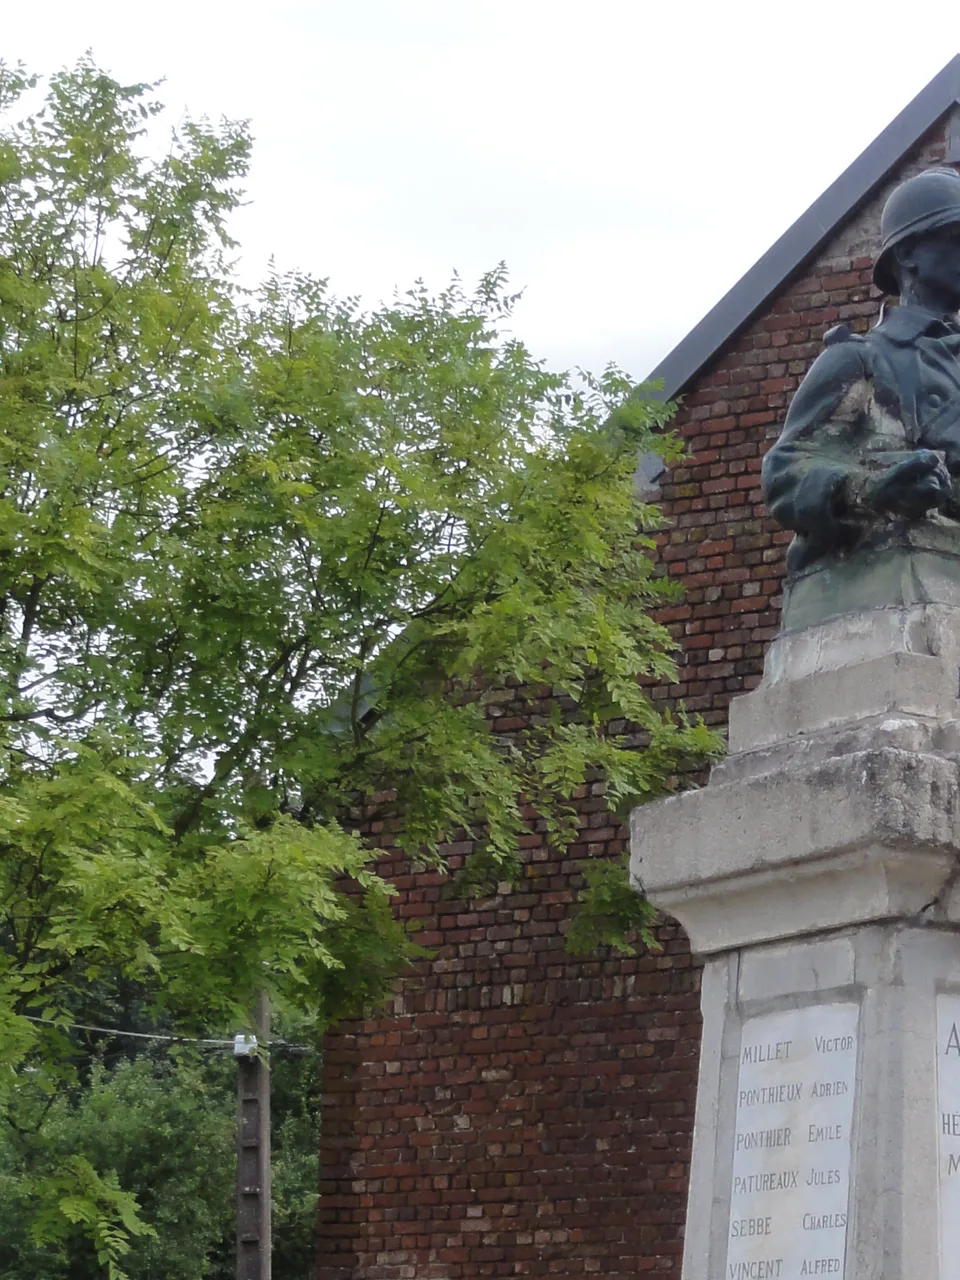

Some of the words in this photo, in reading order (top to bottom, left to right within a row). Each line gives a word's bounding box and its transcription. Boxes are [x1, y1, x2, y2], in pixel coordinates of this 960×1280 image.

[741, 1041, 792, 1065] MILLET
[815, 1035, 853, 1053] VICTOR
[739, 1082, 803, 1108] PONTHIEUX
[810, 1080, 848, 1098] ADRIEN
[736, 1127, 791, 1151] PONTHIER
[808, 1124, 842, 1143] EMILE
[733, 1170, 799, 1195] PATUREAUX
[806, 1168, 841, 1186] JULES
[731, 1216, 772, 1238] SEBBE
[802, 1213, 847, 1231] CHARLES
[729, 1258, 783, 1280] VINCENT
[800, 1258, 840, 1276] ALFRED
